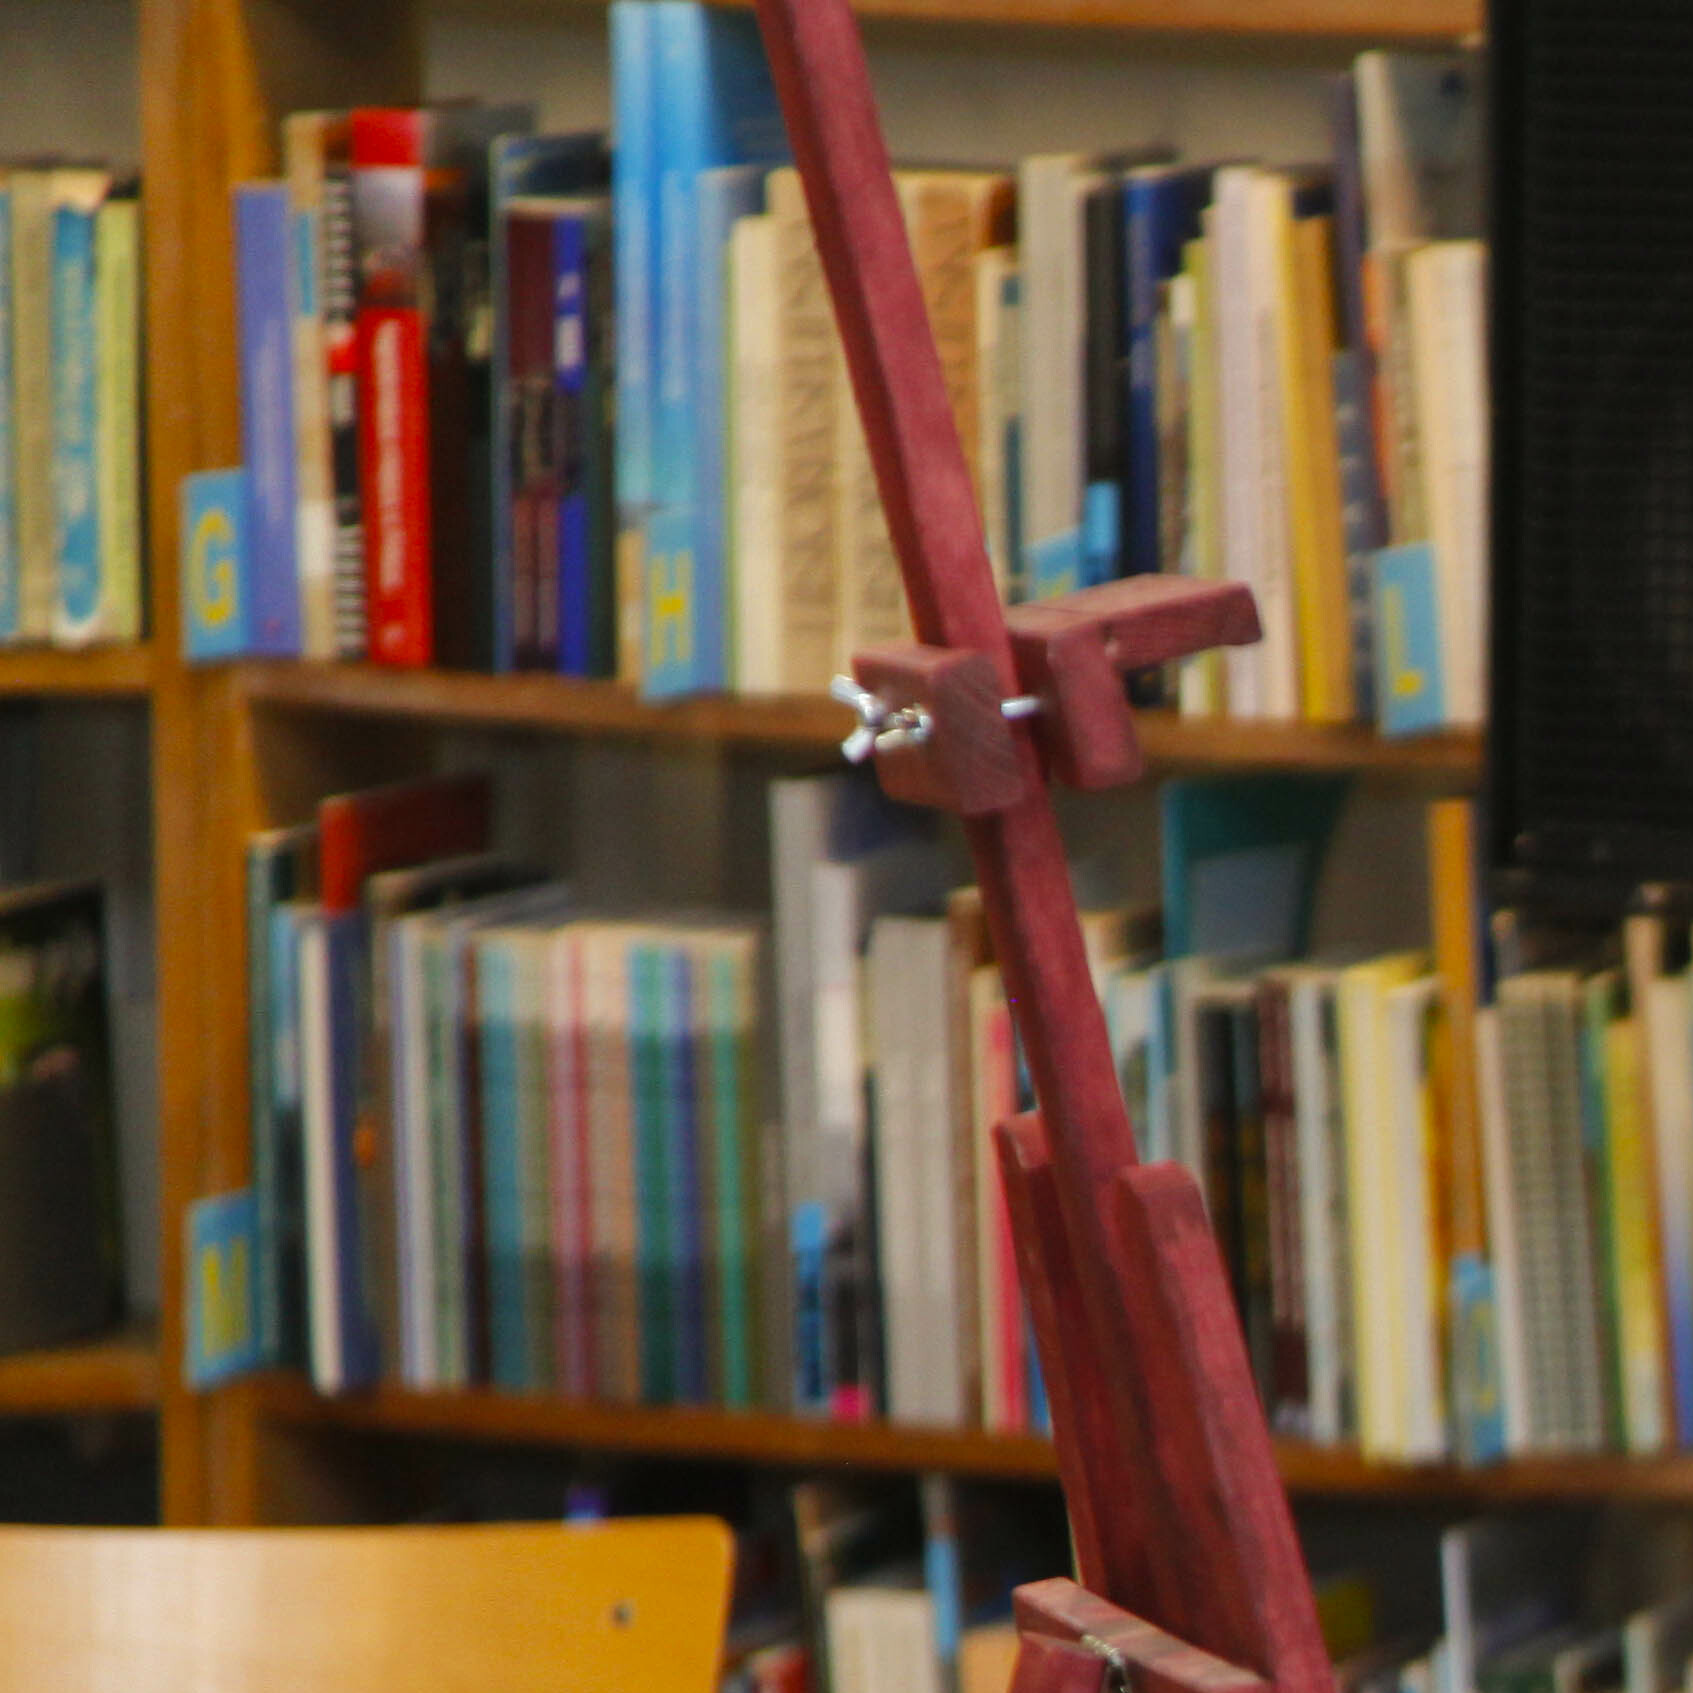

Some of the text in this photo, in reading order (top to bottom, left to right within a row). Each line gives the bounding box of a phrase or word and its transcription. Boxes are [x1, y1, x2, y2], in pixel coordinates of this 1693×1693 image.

[190, 508, 237, 629] G
[650, 549, 693, 668] H
[1381, 584, 1424, 699] L
